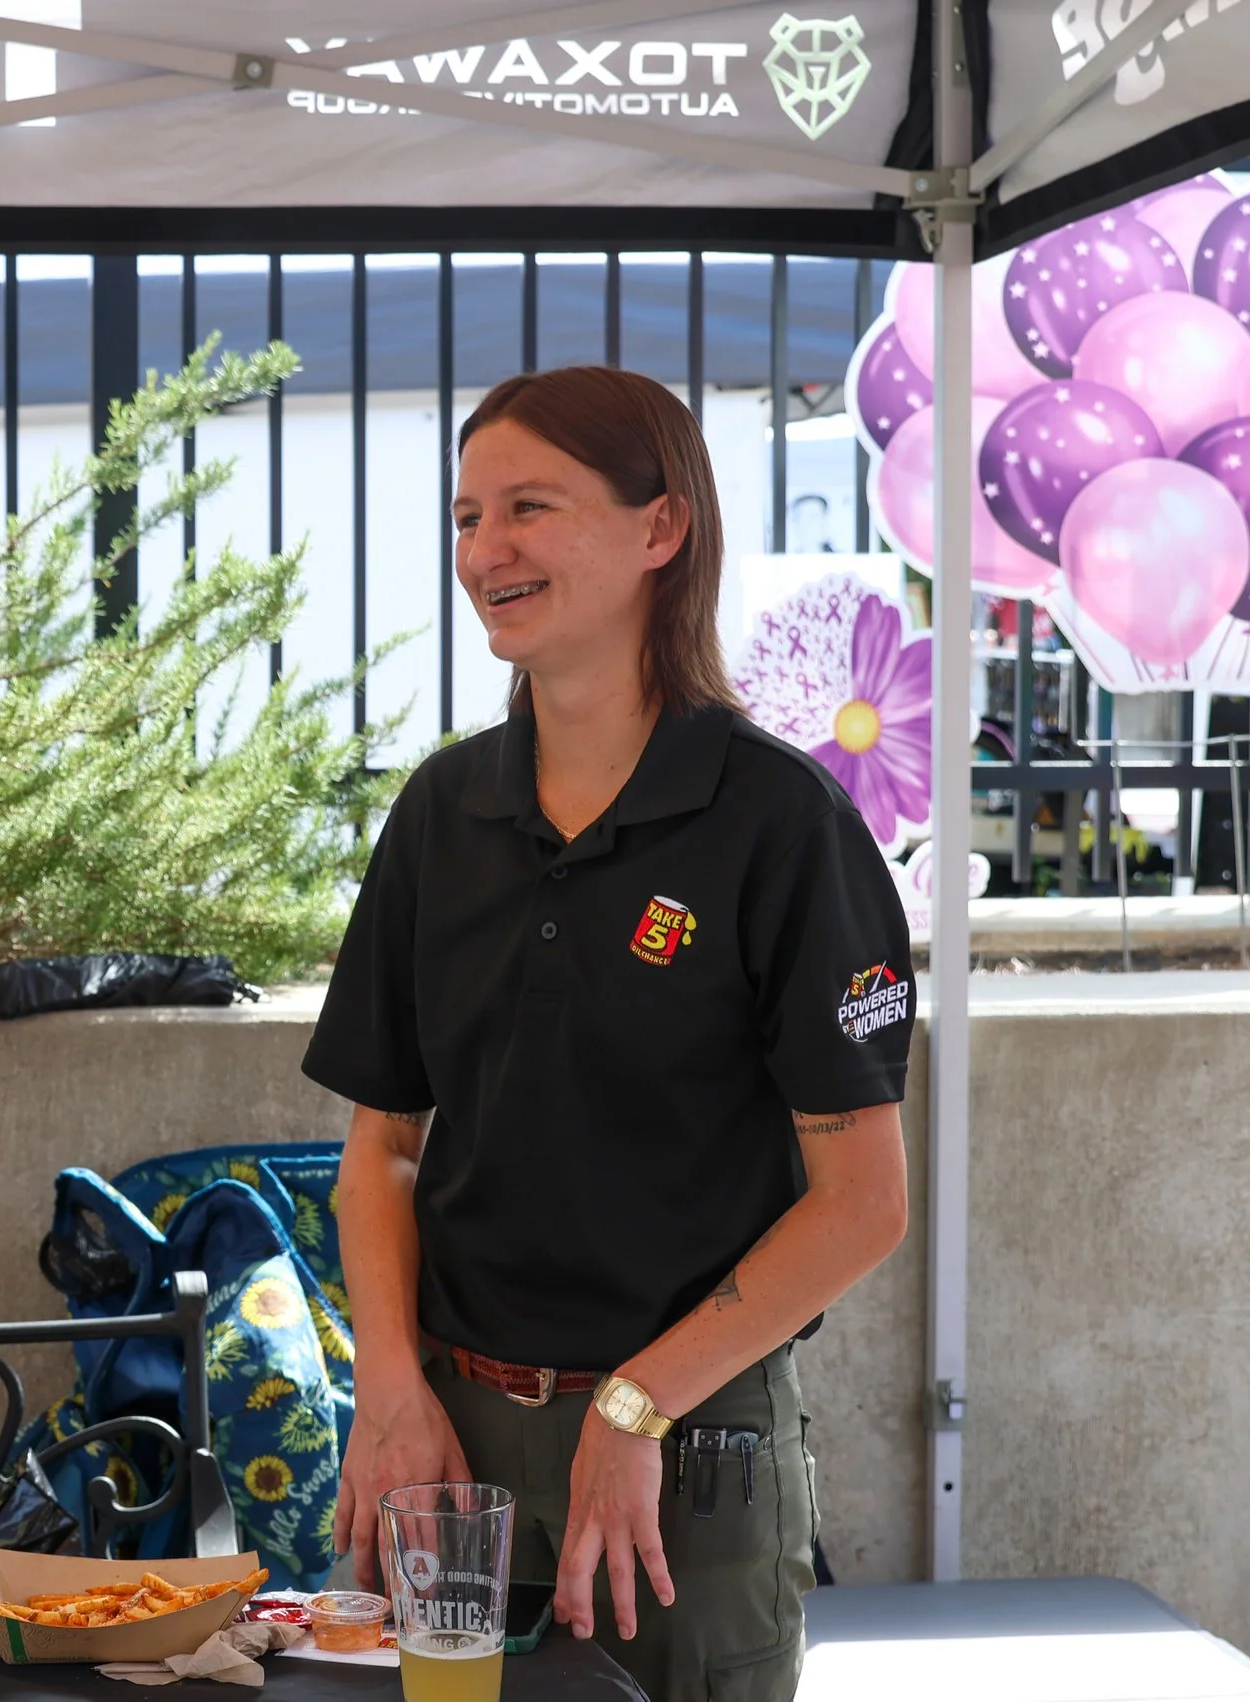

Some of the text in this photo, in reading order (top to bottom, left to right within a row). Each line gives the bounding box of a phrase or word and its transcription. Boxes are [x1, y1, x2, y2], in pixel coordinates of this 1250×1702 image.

[647, 901, 682, 930] TAKE
[640, 923, 669, 950] 5
[837, 980, 909, 1025] POWERED
[853, 998, 907, 1040] WOMEN
